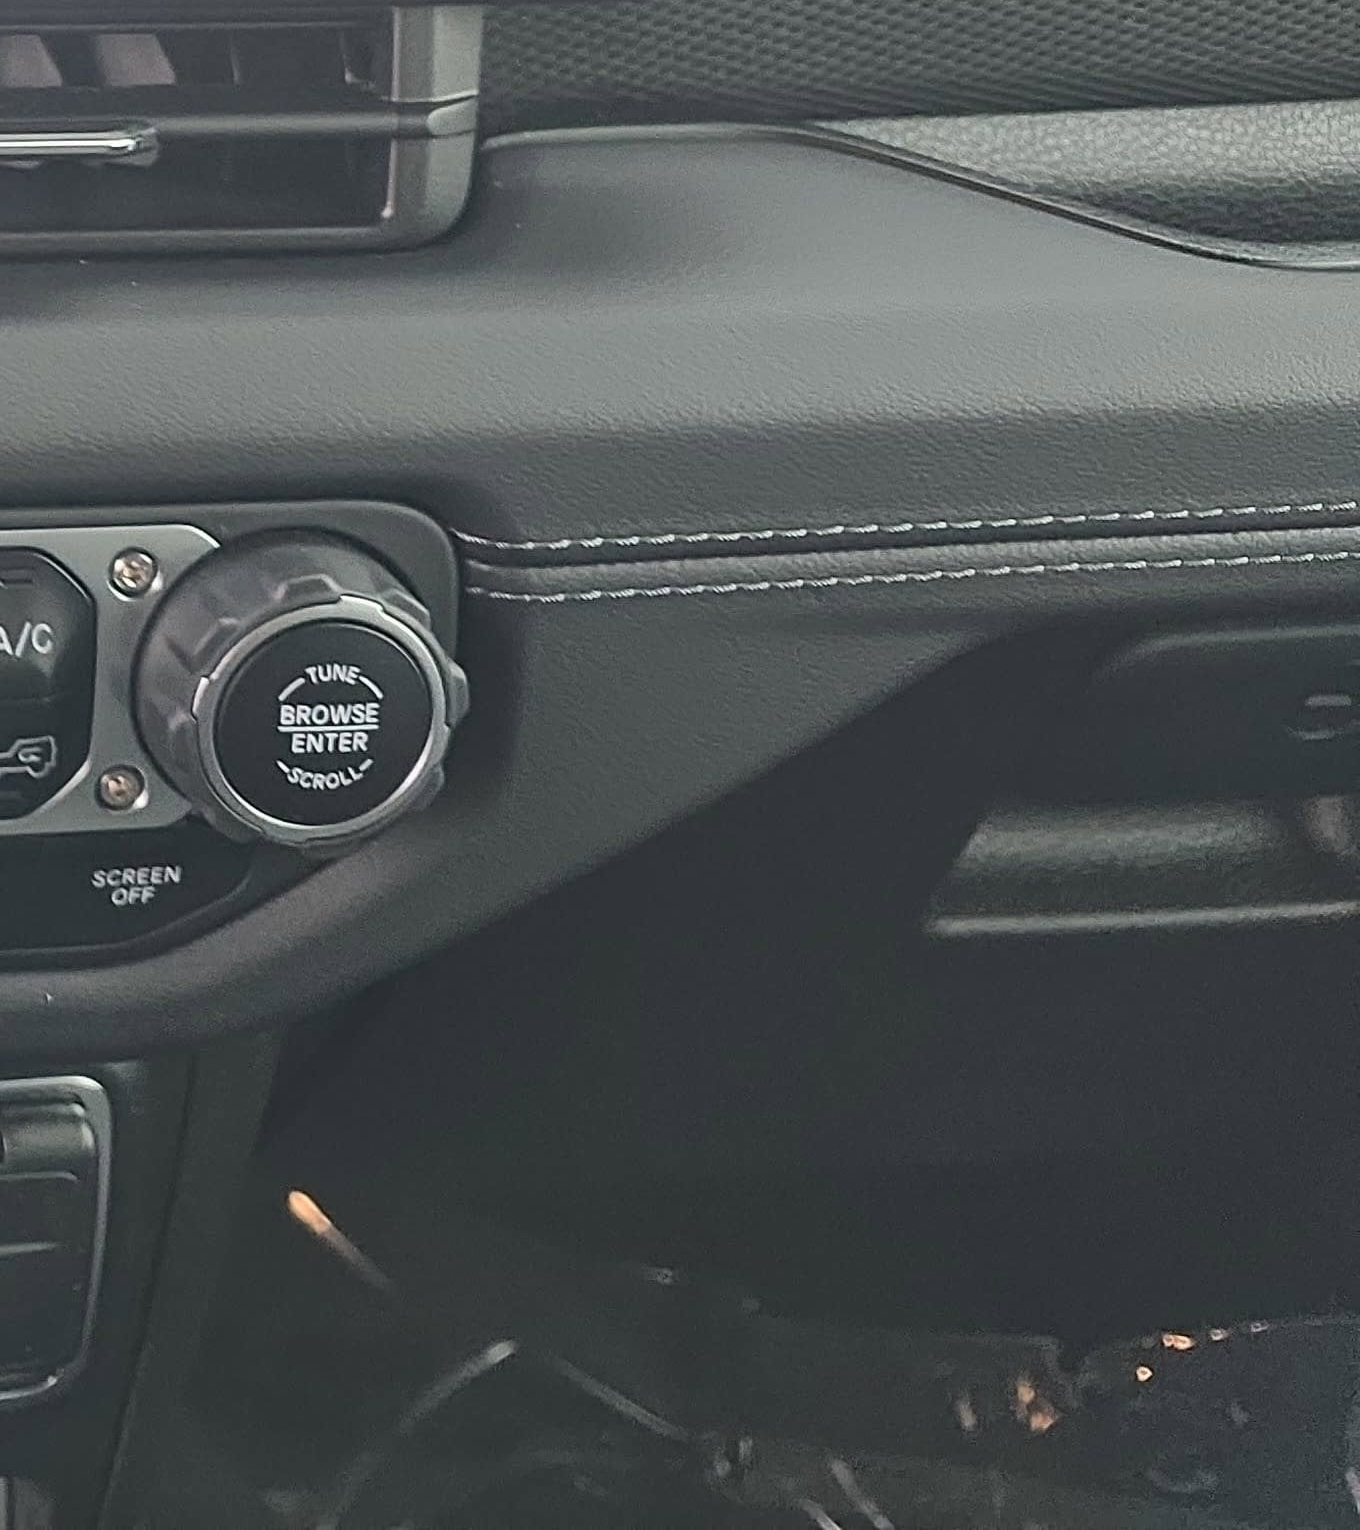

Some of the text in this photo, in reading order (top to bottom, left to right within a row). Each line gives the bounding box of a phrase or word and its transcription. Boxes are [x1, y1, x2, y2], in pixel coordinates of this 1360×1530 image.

[305, 663, 361, 686] TUNE
[280, 703, 380, 724] BROWSE
[291, 732, 368, 754] ENTER
[287, 766, 364, 790] SCROLL
[91, 866, 181, 888] SCREEN
[111, 887, 155, 907] OFF
